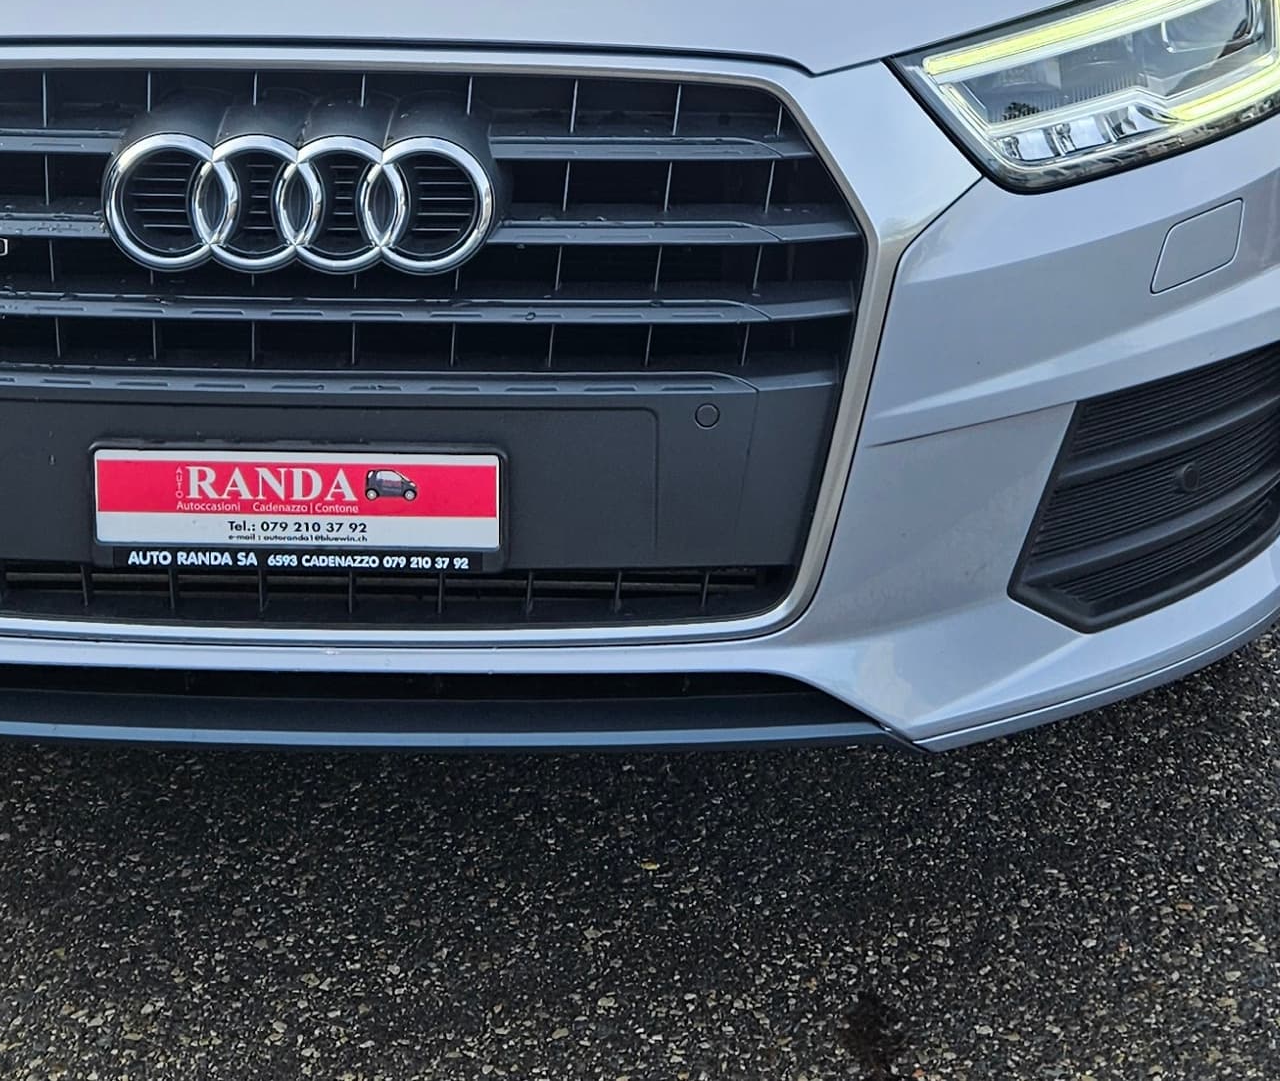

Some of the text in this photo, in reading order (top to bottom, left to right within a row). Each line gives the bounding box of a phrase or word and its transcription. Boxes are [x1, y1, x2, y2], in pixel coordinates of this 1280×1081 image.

[186, 466, 358, 501] RANDA
[176, 501, 241, 512] Autoccasioni
[253, 502, 308, 513] Cadenazzo
[315, 503, 359, 514] Contone
[227, 520, 367, 533] Tel.: 079 210 37 92
[128, 550, 469, 570] AUTO RANDA SA 6593 CADENAZZO 079 210 37 92
